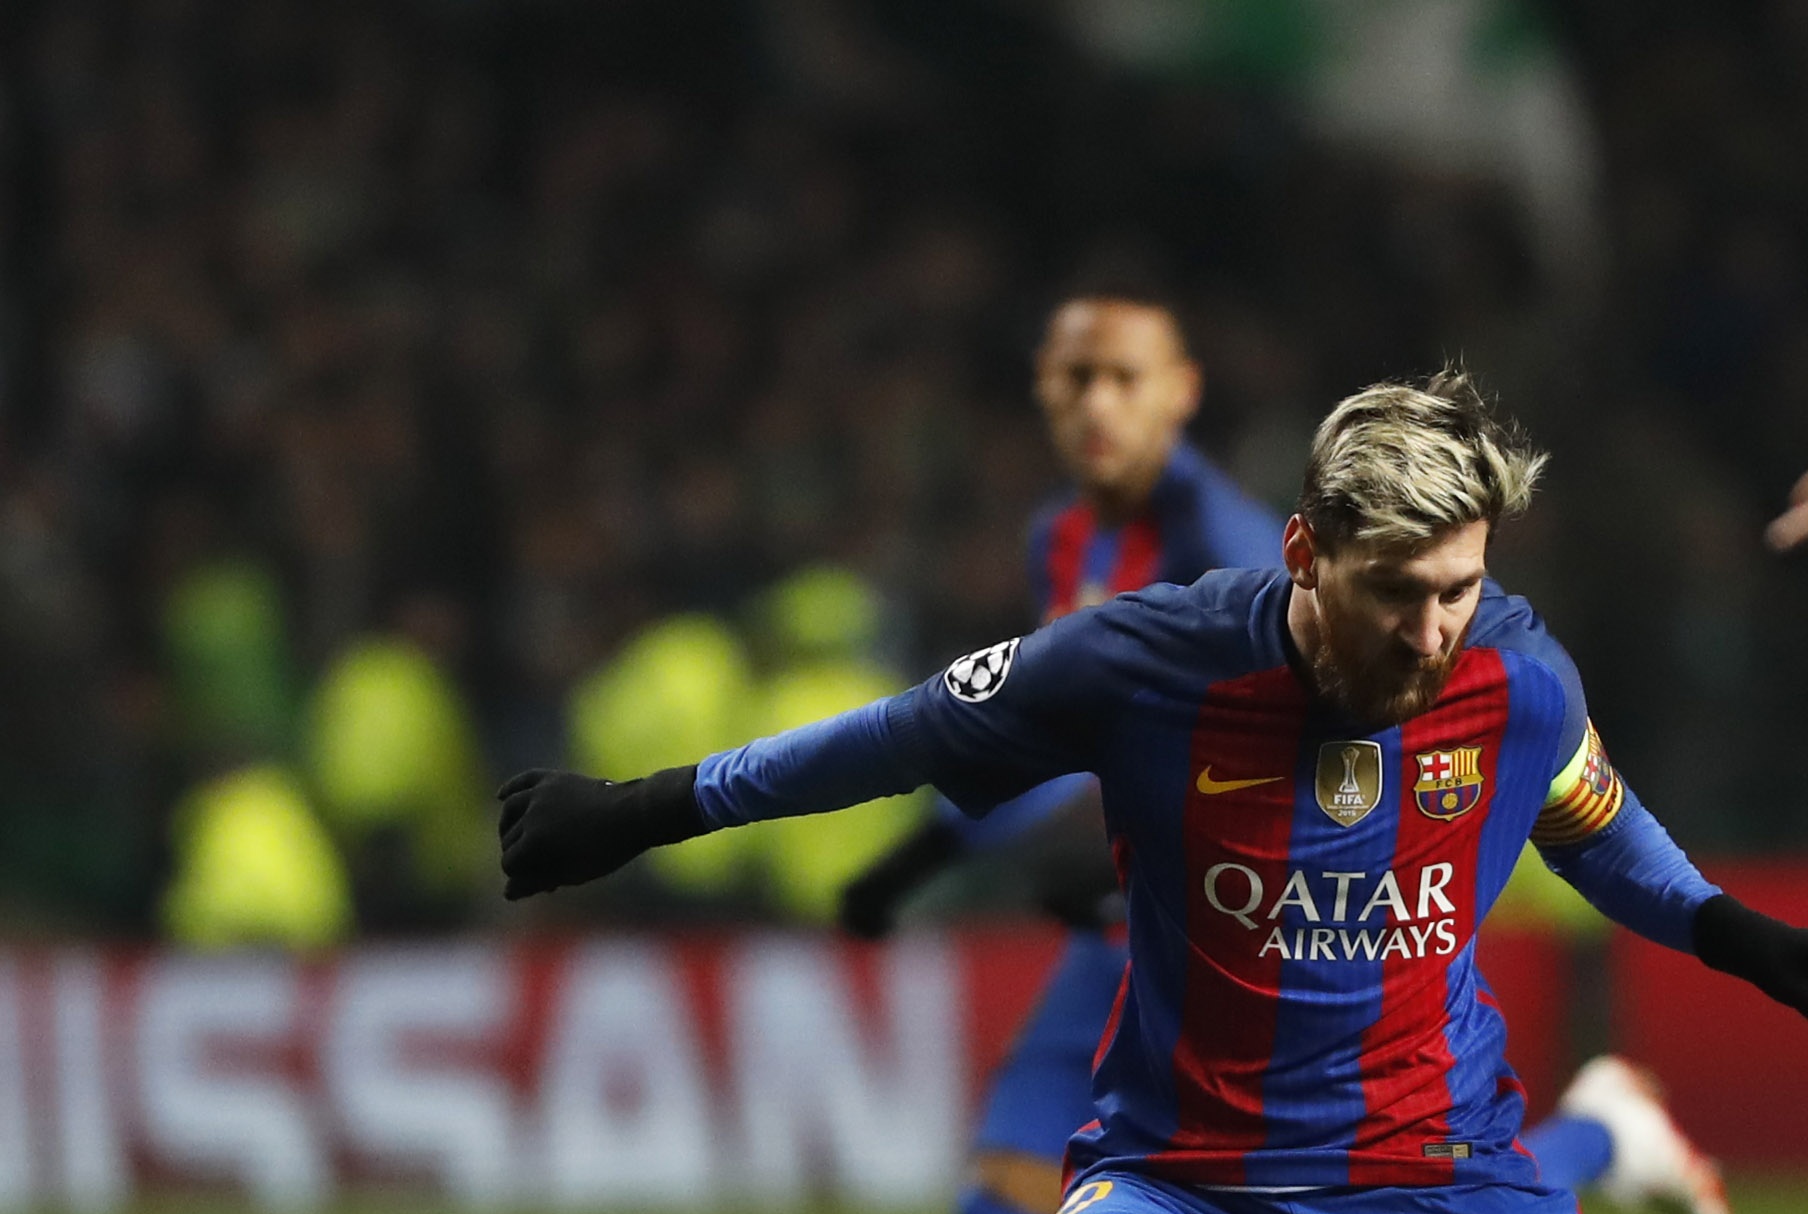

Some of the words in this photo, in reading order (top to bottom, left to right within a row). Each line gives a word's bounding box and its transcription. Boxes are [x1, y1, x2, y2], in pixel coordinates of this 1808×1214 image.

[1435, 778, 1463, 789] FCB
[1333, 794, 1364, 806] FIFA
[1203, 861, 1457, 931] QATAR
[1257, 918, 1457, 962] AIRWAYS
